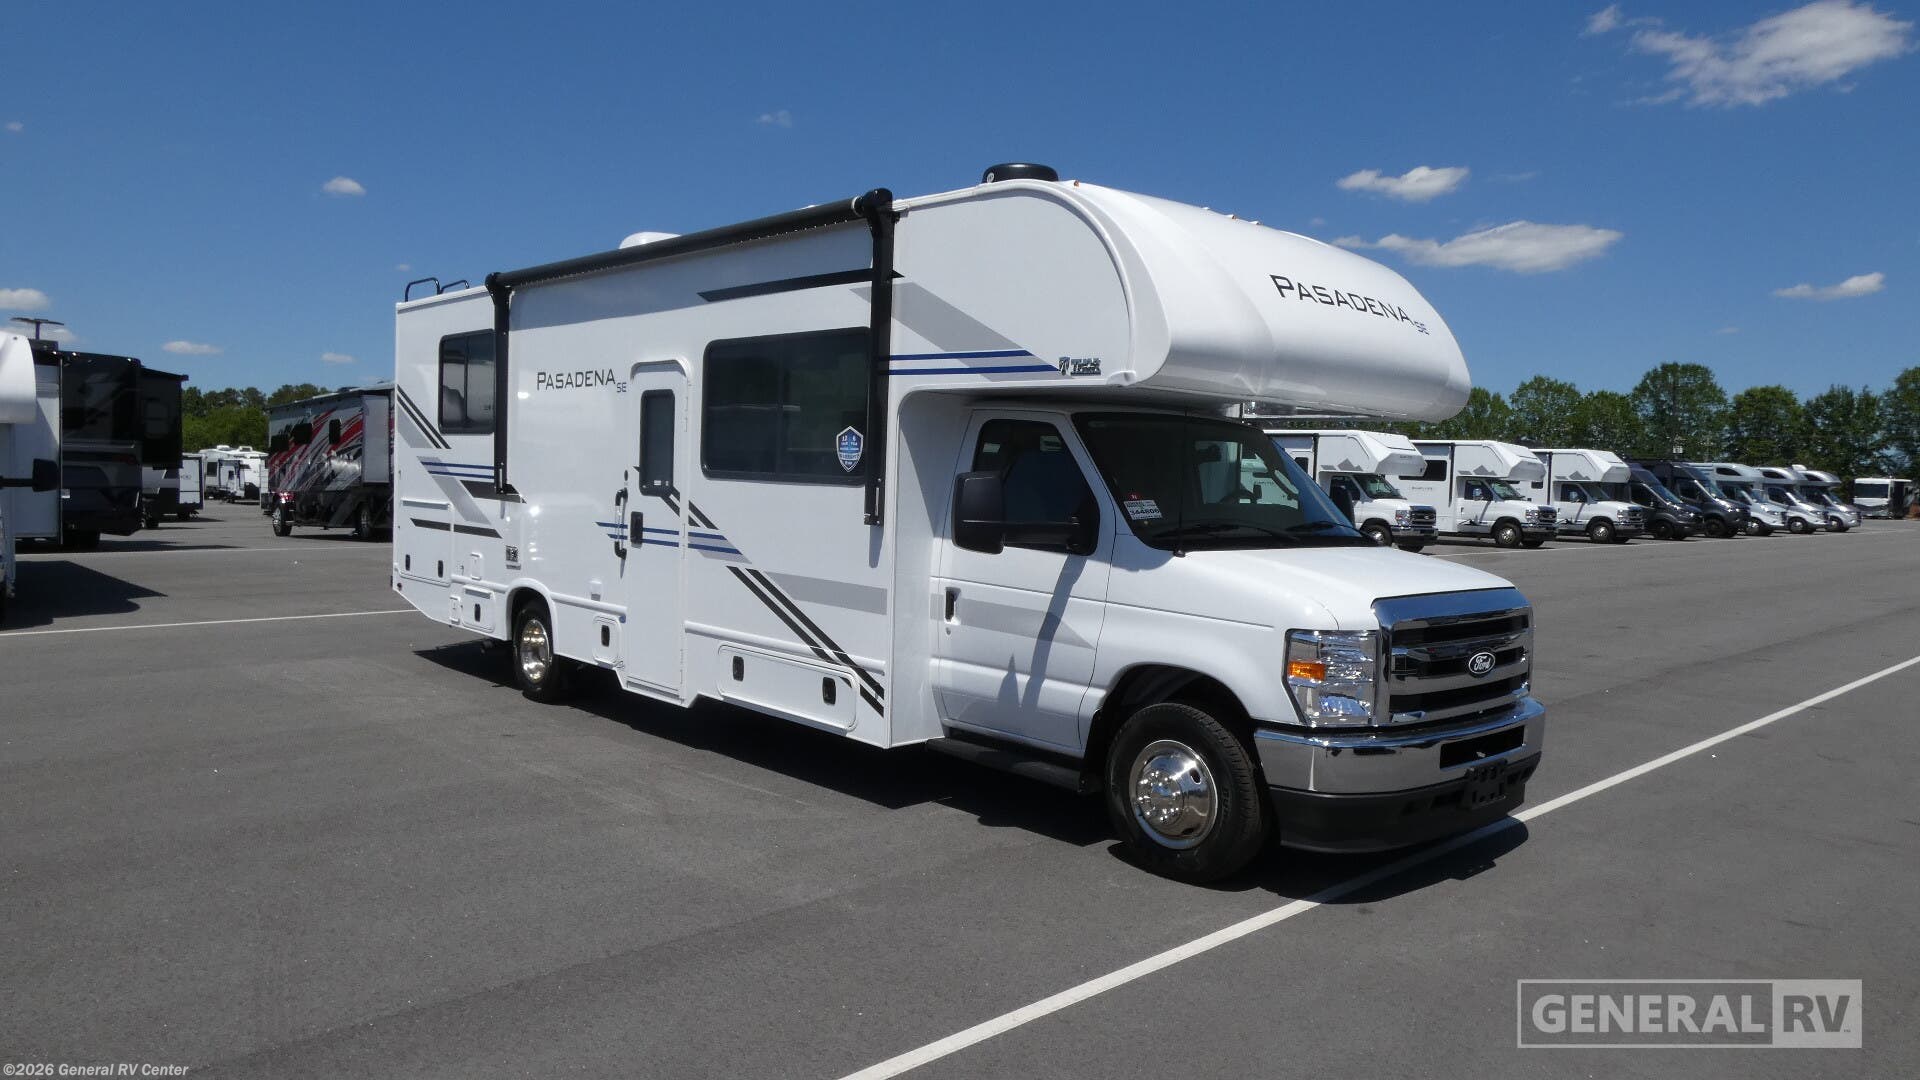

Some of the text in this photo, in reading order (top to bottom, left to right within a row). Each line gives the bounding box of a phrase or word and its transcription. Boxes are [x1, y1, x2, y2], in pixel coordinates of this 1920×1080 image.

[1269, 274, 1415, 326] PASADENA
[537, 368, 627, 393] PASADENA SE
[1473, 655, 1492, 671] Ford
